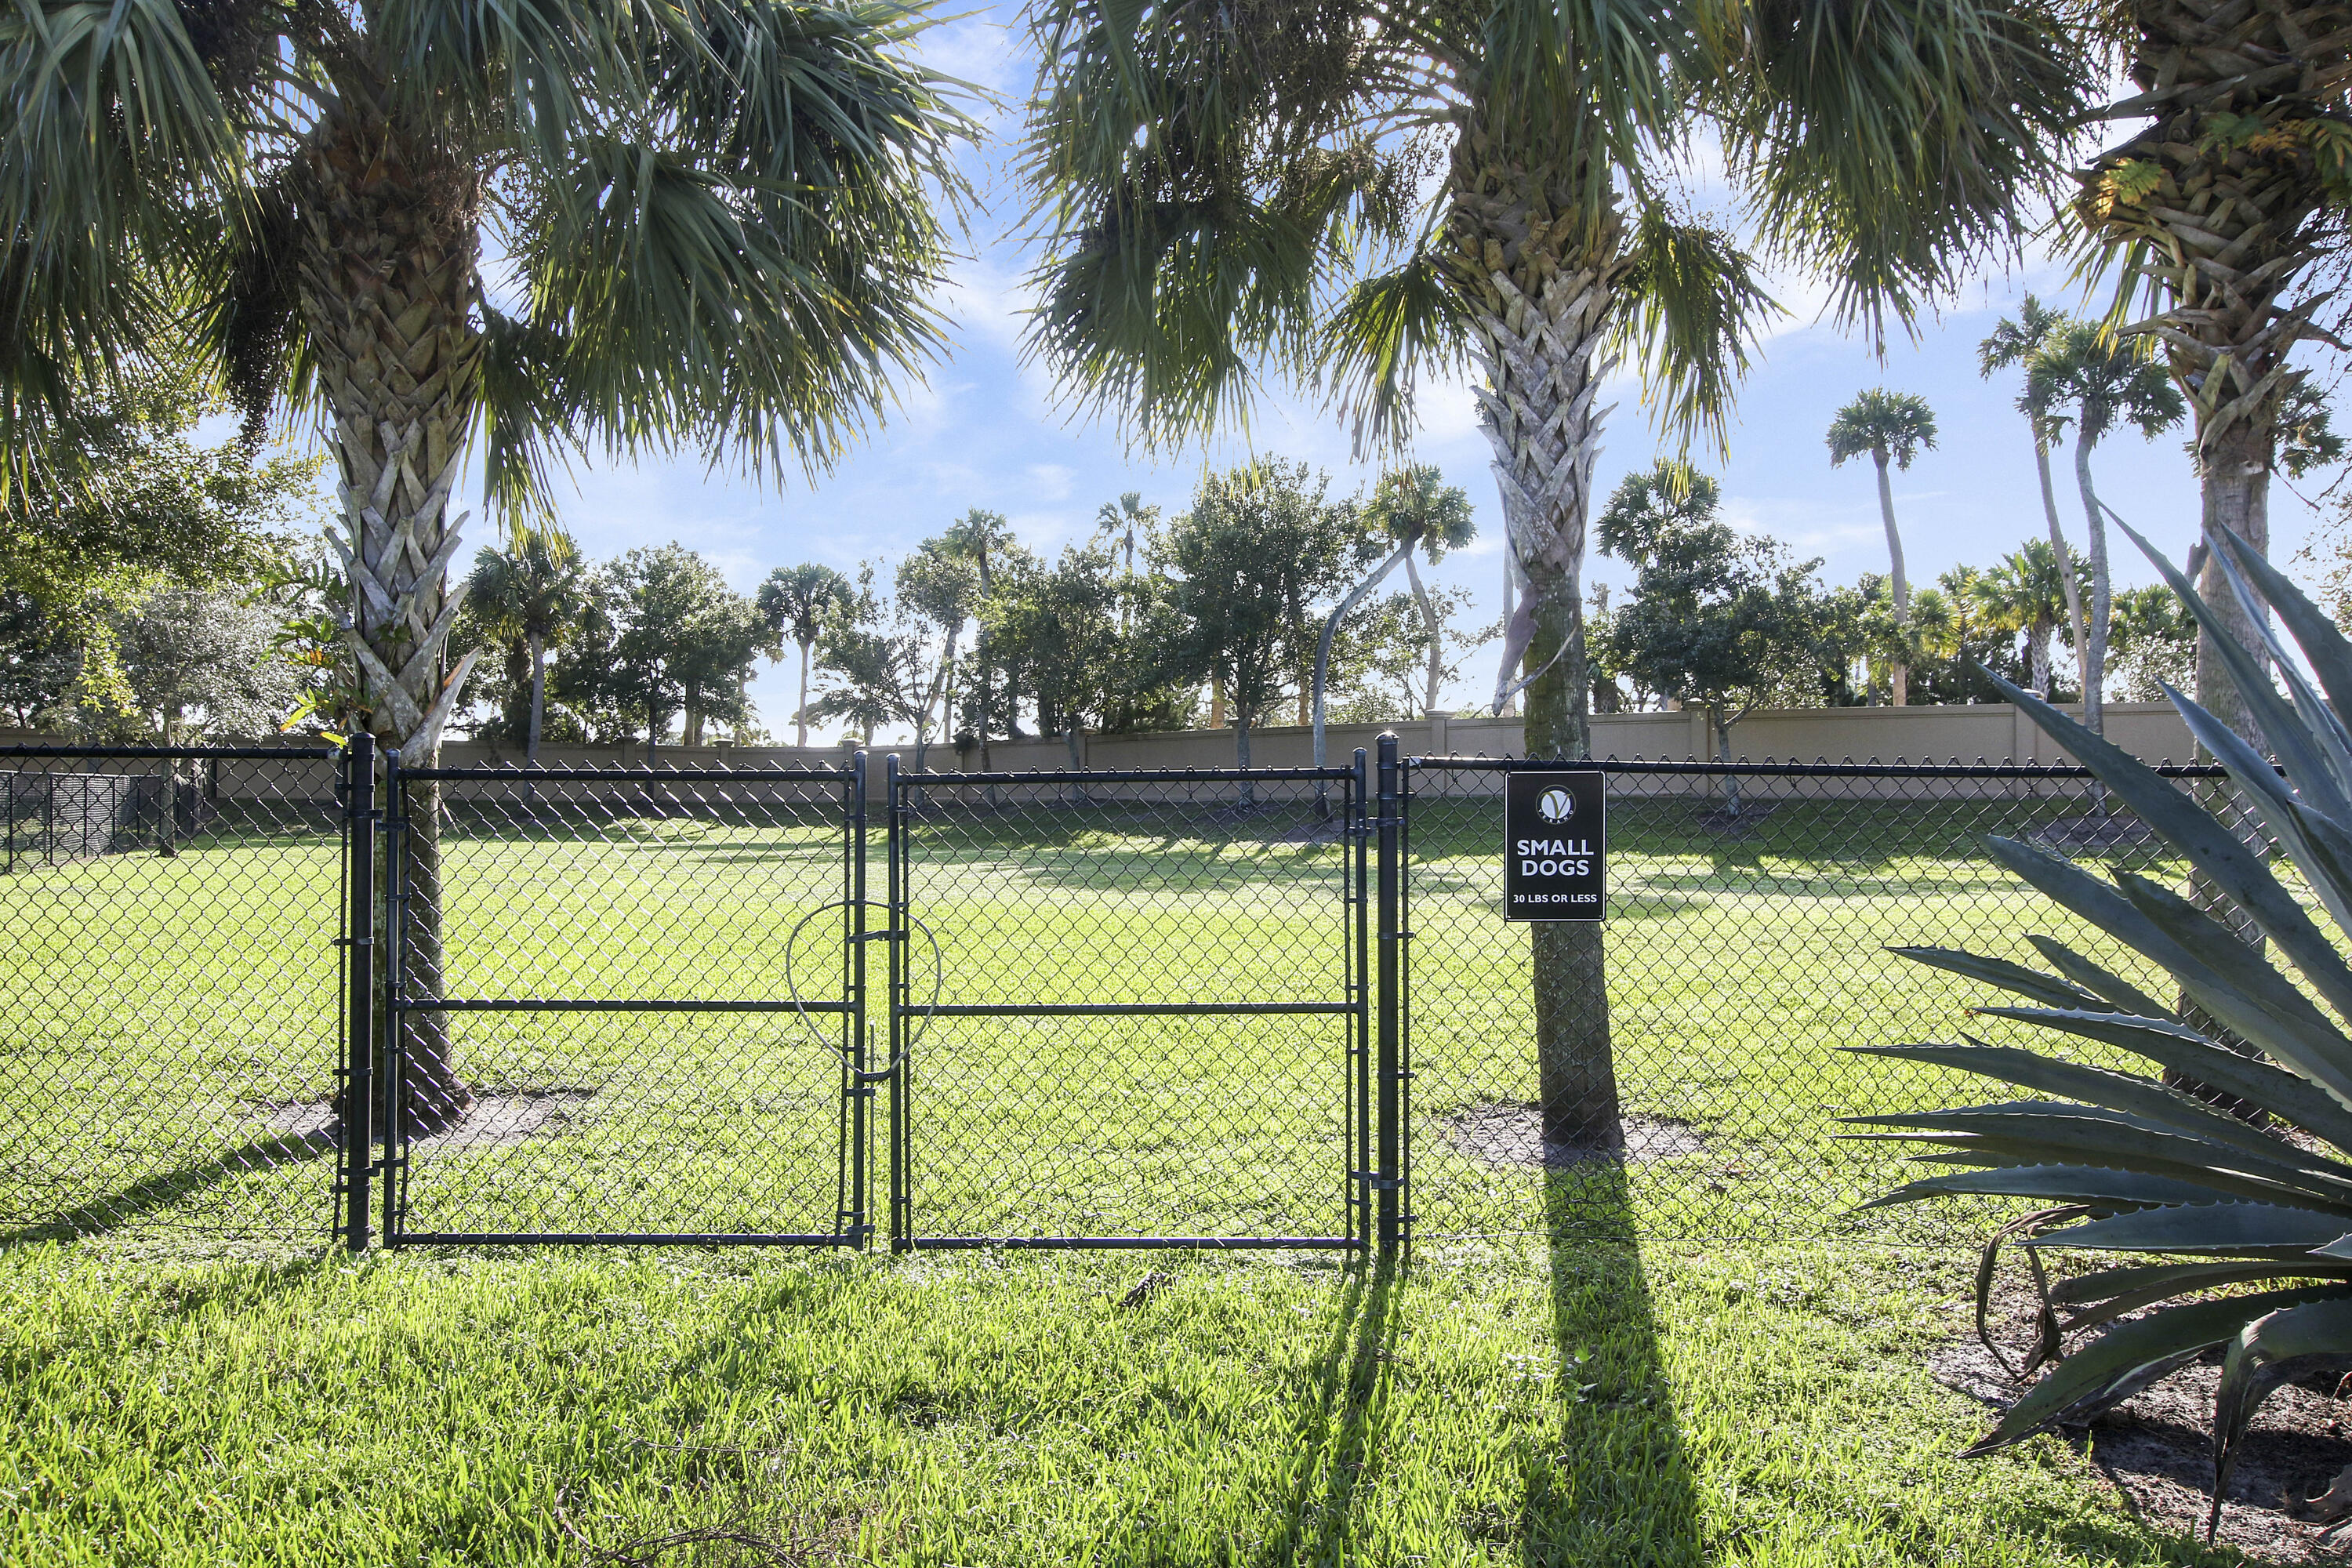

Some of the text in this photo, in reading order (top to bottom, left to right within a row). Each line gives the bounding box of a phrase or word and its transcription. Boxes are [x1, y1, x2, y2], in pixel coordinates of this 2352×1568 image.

[1517, 839, 1594, 856] SMALL
[1522, 859, 1590, 877] DOGS
[1513, 894, 1598, 903] 30 LBS OR LESS
